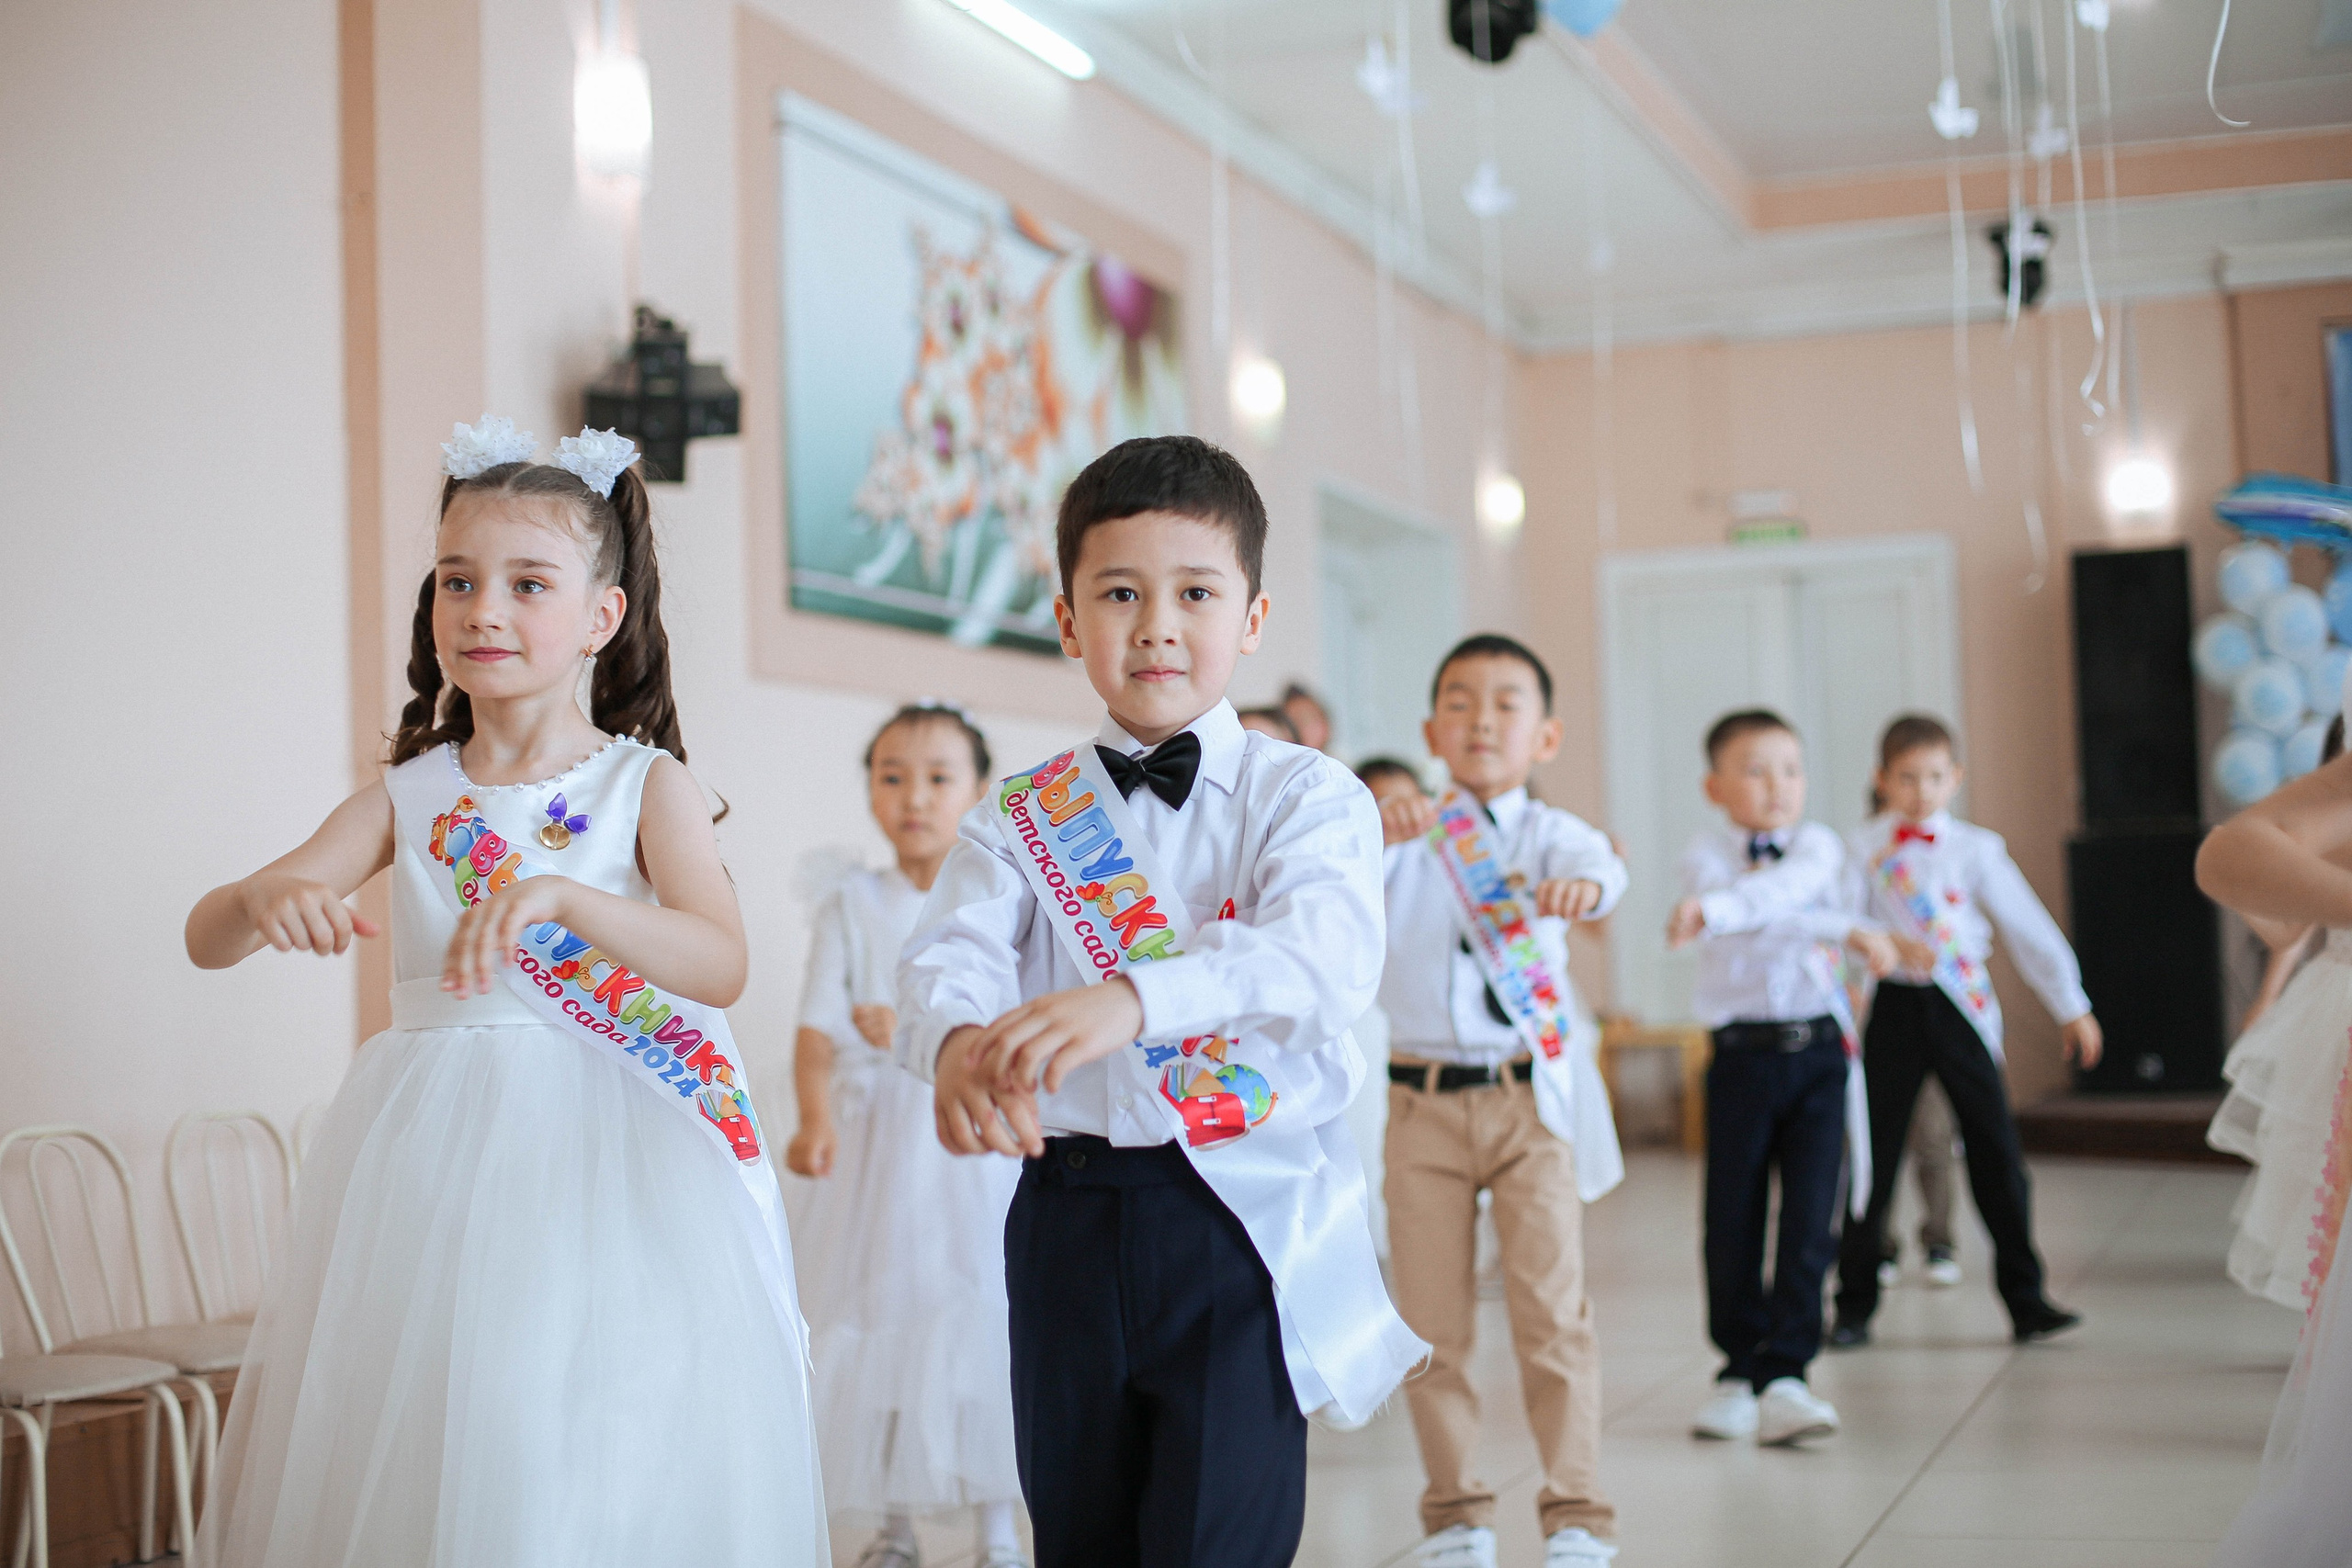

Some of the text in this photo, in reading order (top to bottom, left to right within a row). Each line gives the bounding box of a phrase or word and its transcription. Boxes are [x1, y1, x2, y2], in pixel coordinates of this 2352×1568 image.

[1006, 789, 1082, 917] детского
[562, 999, 629, 1045] сада
[624, 1035, 702, 1099] 2024
